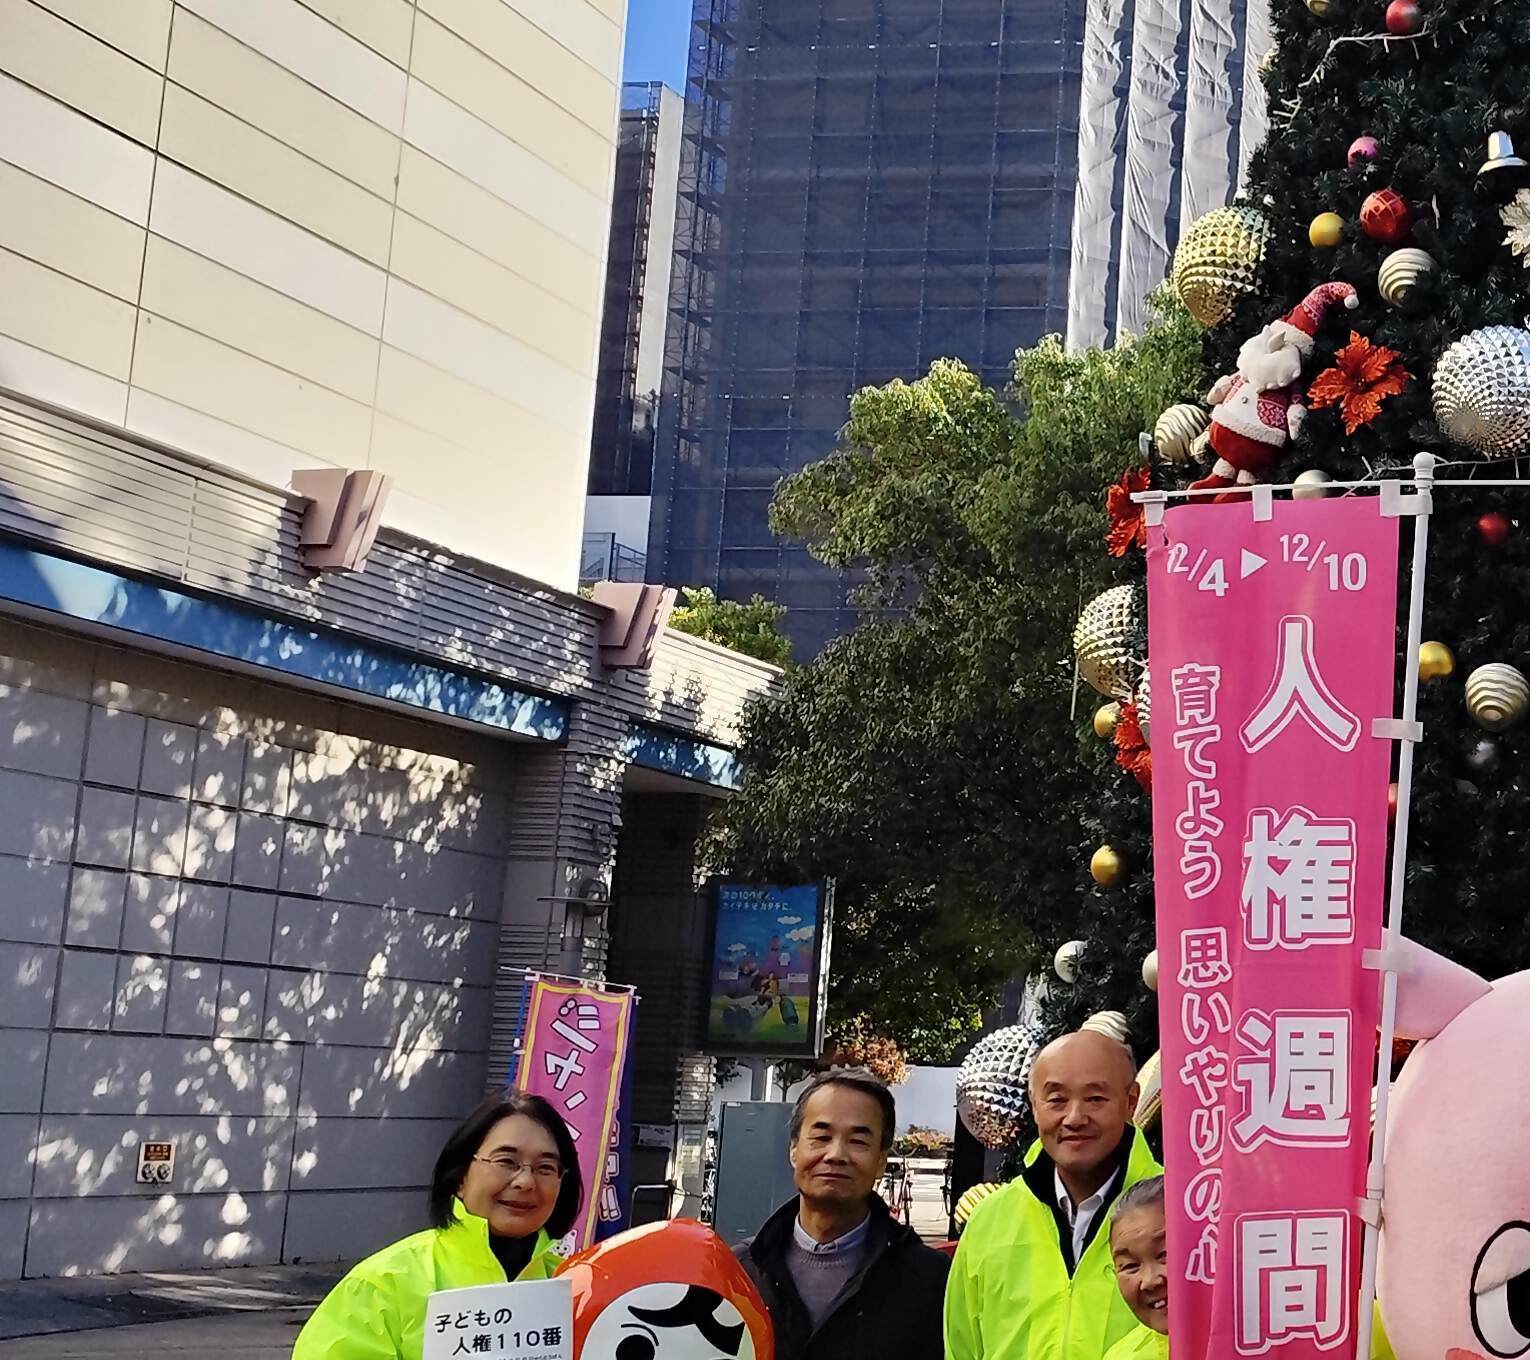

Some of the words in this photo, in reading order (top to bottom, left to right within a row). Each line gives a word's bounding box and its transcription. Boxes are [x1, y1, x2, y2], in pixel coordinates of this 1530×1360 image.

[1166, 541, 1230, 597] 12/4
[1279, 533, 1368, 591] 12/10
[1171, 662, 1224, 901] 育てよう
[1230, 615, 1361, 1357] 人権週間
[434, 1308, 512, 1333] 子どもの
[452, 1326, 562, 1356] 人権110番
